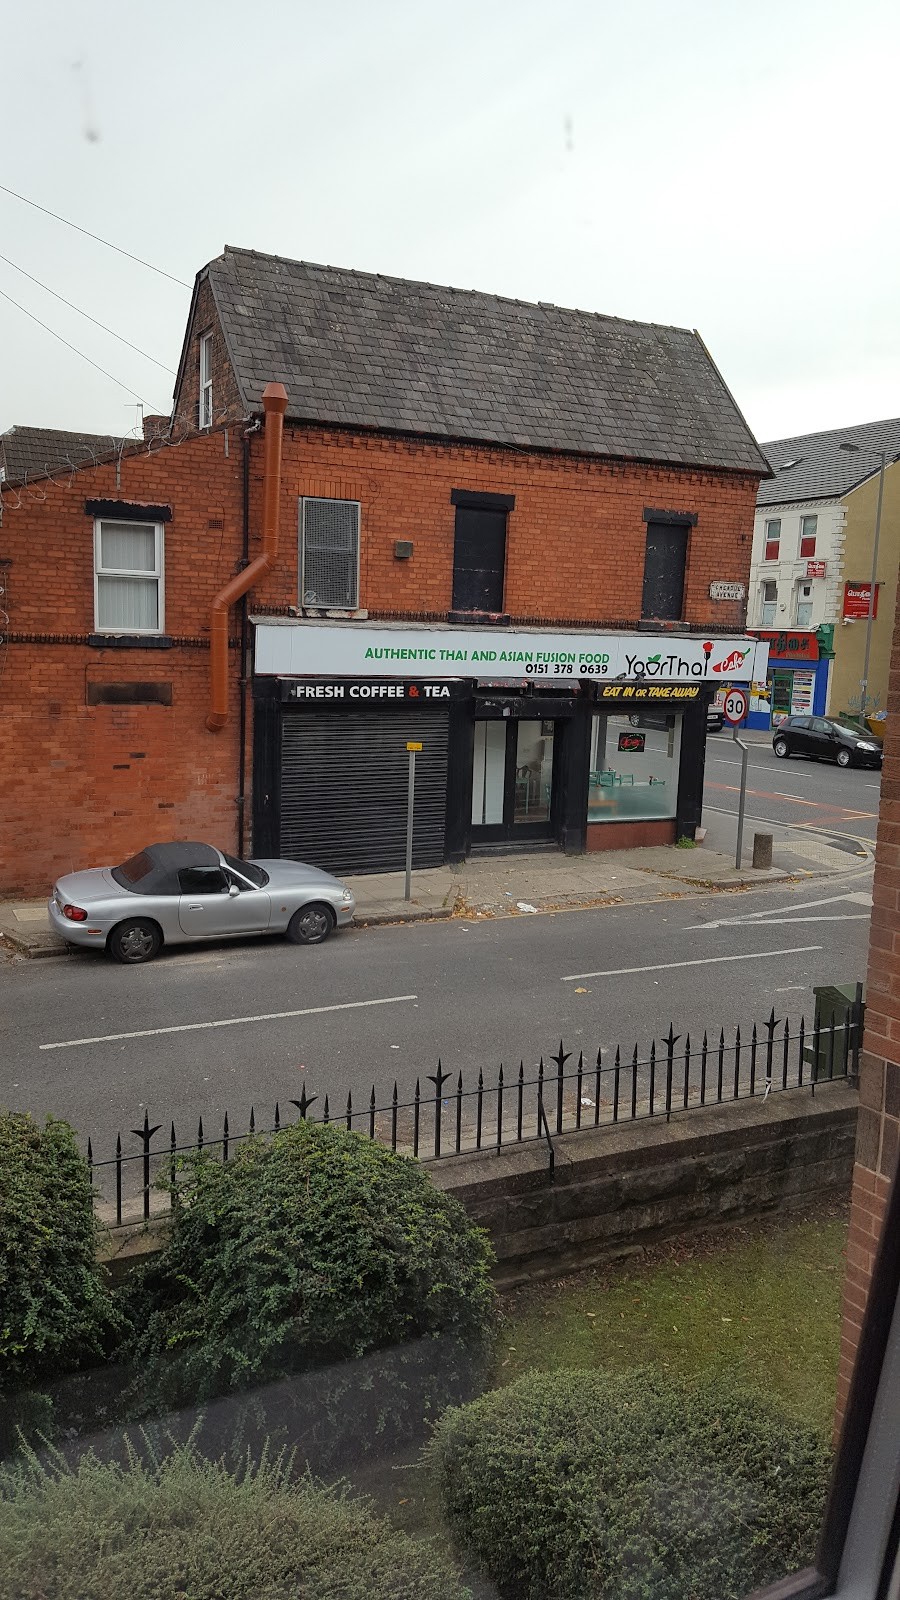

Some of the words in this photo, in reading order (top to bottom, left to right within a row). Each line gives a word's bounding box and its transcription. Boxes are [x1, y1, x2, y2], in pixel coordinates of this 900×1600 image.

[364, 647, 437, 660] AUTHENTIC
[439, 649, 468, 661] THAI
[470, 650, 497, 662] AND
[499, 651, 533, 663] ASIAN
[535, 652, 576, 663] FUSION
[578, 653, 610, 664] FOOD
[525, 663, 549, 674] 0151
[553, 664, 574, 675] 378
[579, 664, 608, 675] 0639
[296, 686, 345, 698] FRESH
[349, 686, 405, 698] COFFEE
[408, 686, 420, 698] &
[423, 686, 451, 698] TEA
[602, 686, 624, 697] EAT
[622, 686, 635, 697] IN
[726, 699, 744, 715] 30
